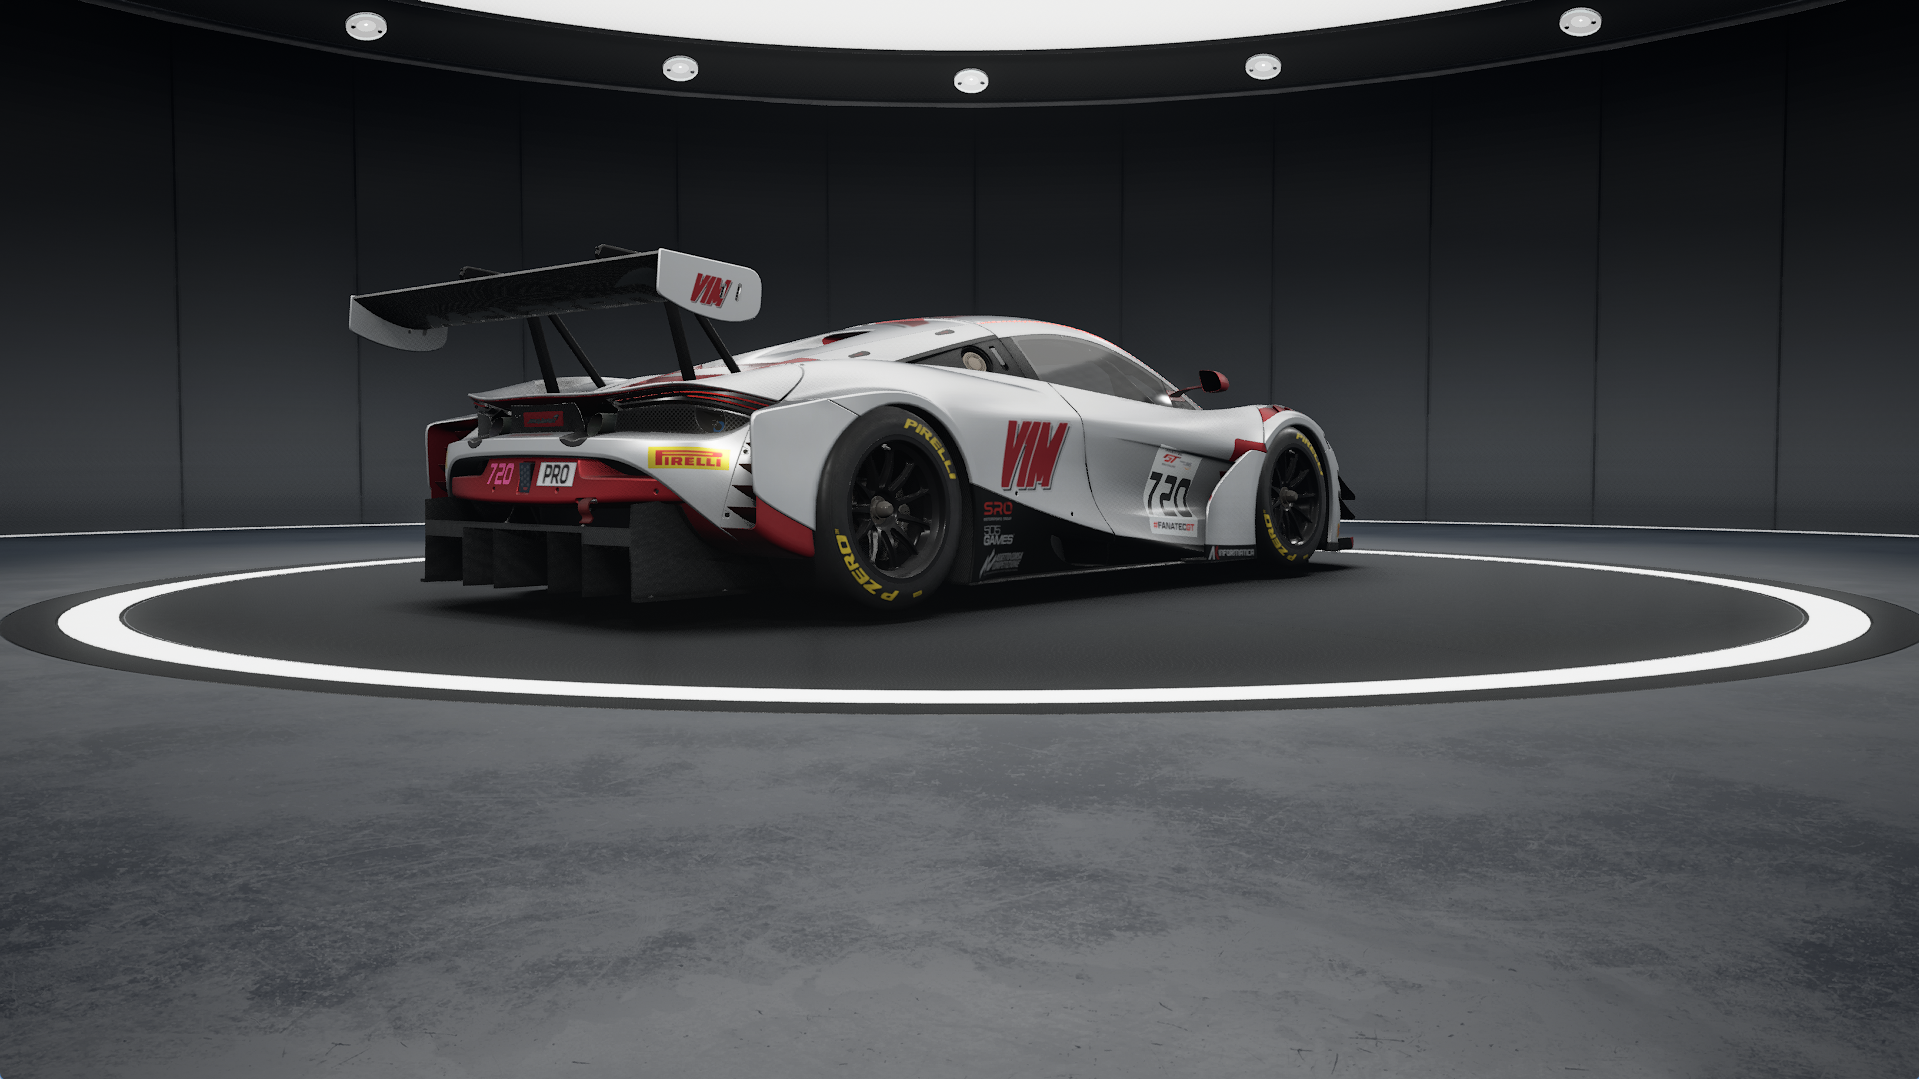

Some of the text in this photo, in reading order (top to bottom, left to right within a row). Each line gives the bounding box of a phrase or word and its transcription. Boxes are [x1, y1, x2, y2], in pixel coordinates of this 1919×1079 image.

[690, 273, 733, 308] VIM
[655, 450, 723, 467] PIRELLI
[904, 418, 957, 480] PIRELLI
[1001, 420, 1070, 490] VIM
[1296, 432, 1324, 476] PIRELLI
[487, 463, 514, 485] 720
[542, 464, 570, 485] PRO
[1148, 471, 1193, 517] 720
[983, 501, 1013, 516] SRO
[983, 525, 1001, 535] 505
[983, 534, 1014, 546] GAMES
